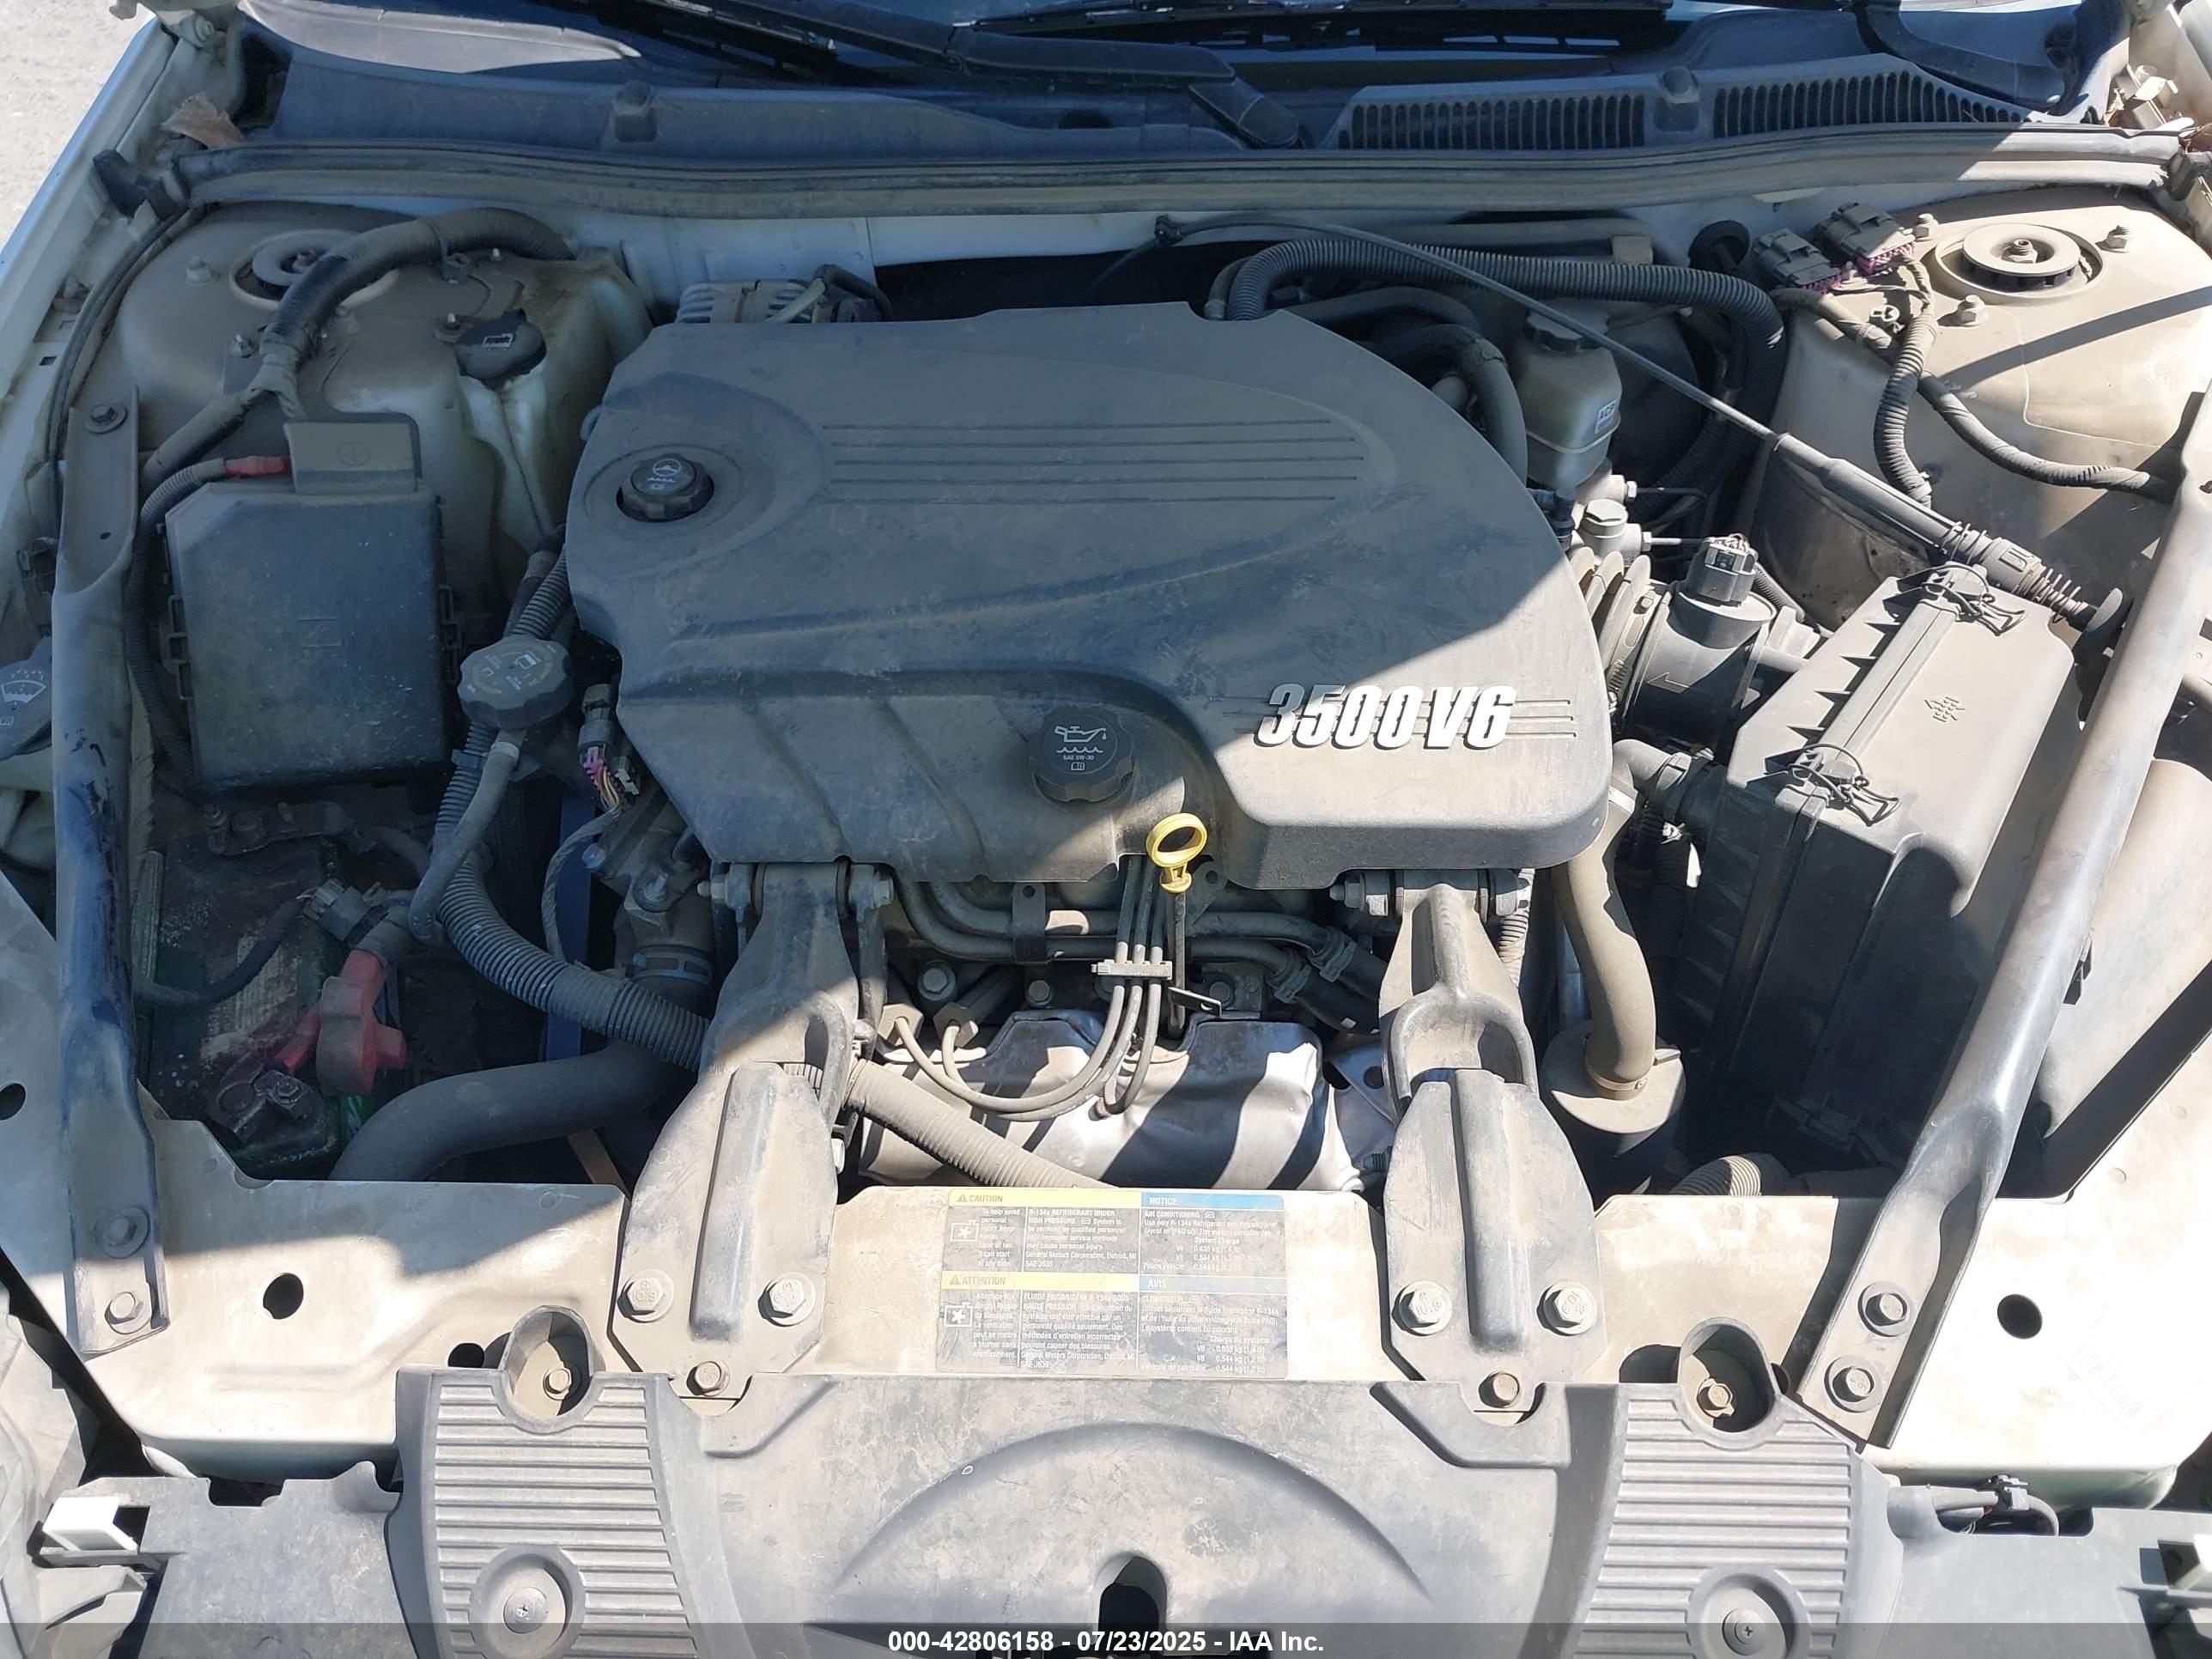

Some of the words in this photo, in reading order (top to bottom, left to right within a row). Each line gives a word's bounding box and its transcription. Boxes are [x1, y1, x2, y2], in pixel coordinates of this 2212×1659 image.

[1149, 1196, 1177, 1206] NOTICE
[1071, 1226, 1097, 1235] qualified
[1144, 1227, 1163, 1237] Glycol
[1147, 1279, 1167, 1288] AVIS
[1023, 1302, 1043, 1310] HAUTE
[1210, 1335, 1232, 1344] Charge
